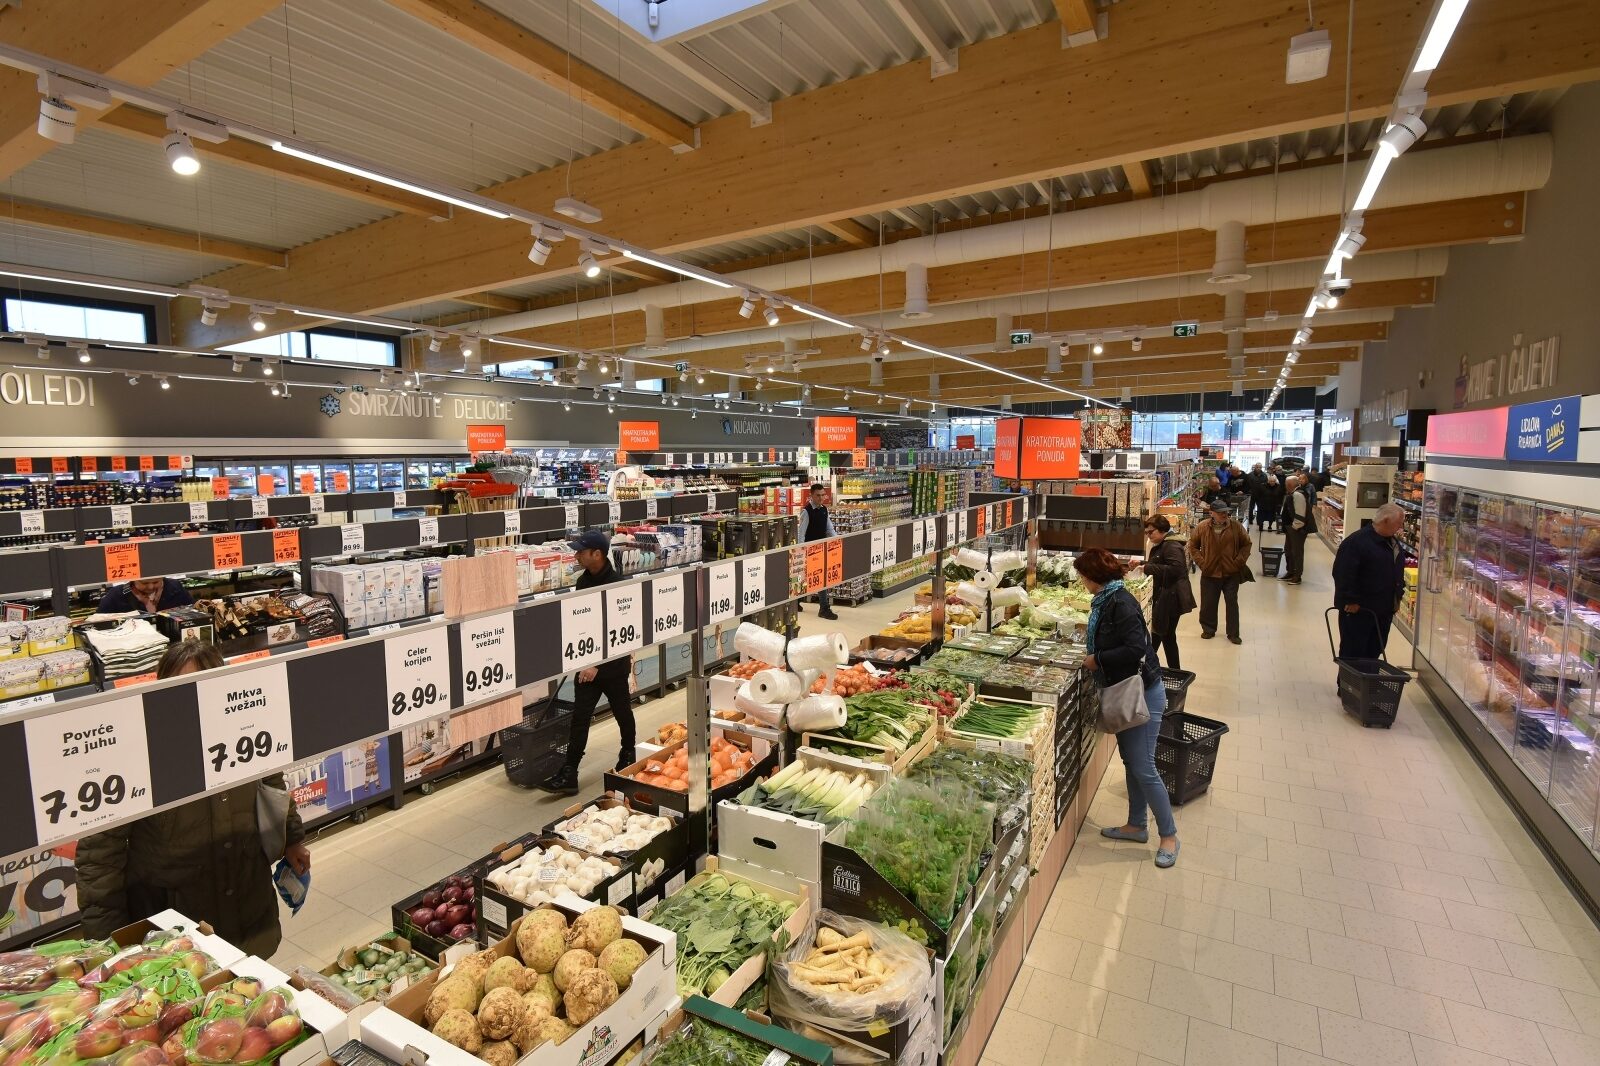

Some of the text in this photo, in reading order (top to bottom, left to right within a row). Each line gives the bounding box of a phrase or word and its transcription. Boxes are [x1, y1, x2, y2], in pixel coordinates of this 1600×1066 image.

[1508, 334, 1561, 395] ČAJEVI
[0, 371, 95, 407] OLEDI
[349, 391, 443, 418] SMRZNUTE
[1546, 420, 1564, 443] DANAS
[1026, 435, 1077, 447] KRATKOTRAJNA
[1036, 450, 1065, 462] PONUDA
[217, 557, 238, 566] 73.99
[275, 551, 295, 559] 14.99
[743, 589, 761, 606] 9.99
[572, 607, 591, 616] Koraba
[710, 598, 730, 616] 11.99
[654, 613, 678, 633] 16.99
[471, 627, 505, 641] Peršin list
[475, 636, 501, 649] svežanj
[609, 624, 635, 647] 7.99
[407, 647, 428, 657] Celer
[564, 637, 594, 660] 4.99
[404, 655, 432, 667] korijen
[465, 662, 504, 692] 9.99
[226, 687, 262, 702] Mrkva
[391, 683, 437, 716] 8.99
[224, 696, 267, 714] svežanj
[63, 723, 114, 744] Povrće
[62, 736, 117, 757] za juhu
[207, 730, 288, 772] 7.99 kn
[40, 774, 146, 824] 7.99 kn
[294, 785, 312, 798] 50%
